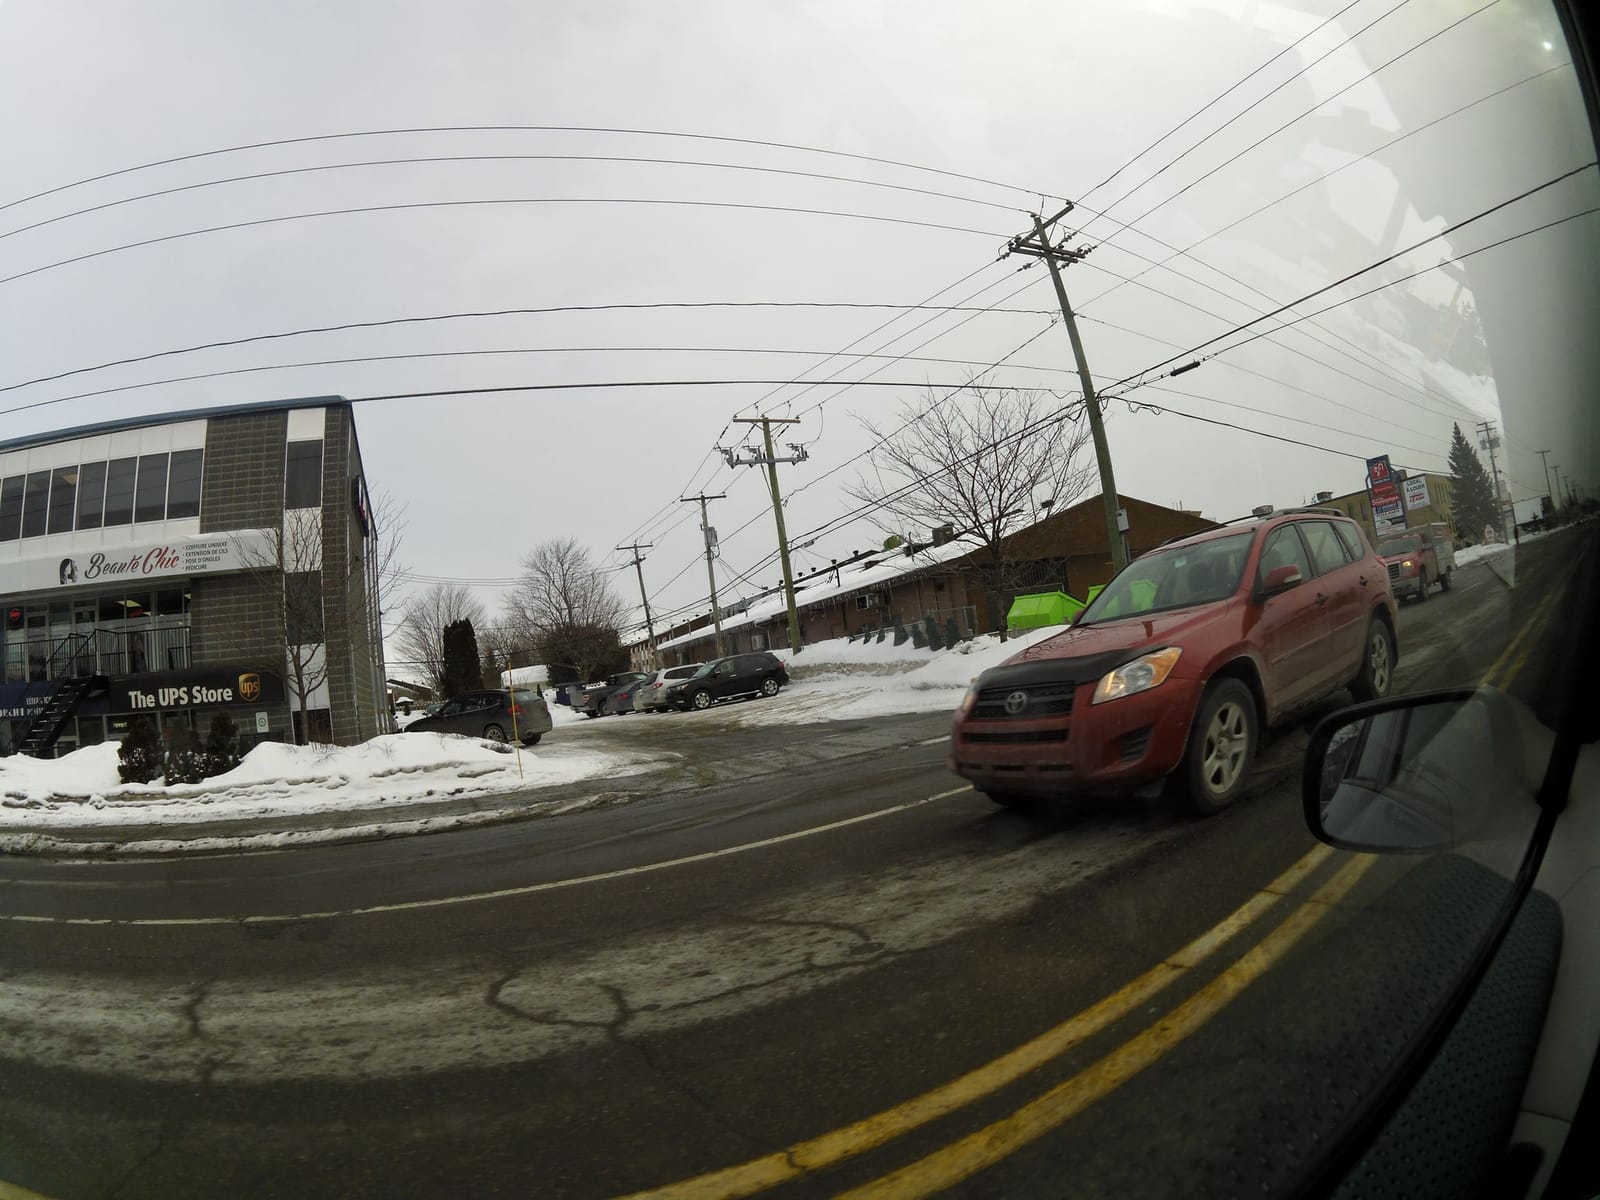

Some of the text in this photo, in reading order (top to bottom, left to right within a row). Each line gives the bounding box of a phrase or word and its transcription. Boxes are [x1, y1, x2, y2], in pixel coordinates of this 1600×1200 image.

[185, 550, 211, 558] EXTENSION
[186, 541, 228, 551] COIFFURE UNISEXE
[84, 546, 181, 580] Beauté Chic
[128, 685, 233, 709] The UPS Store
